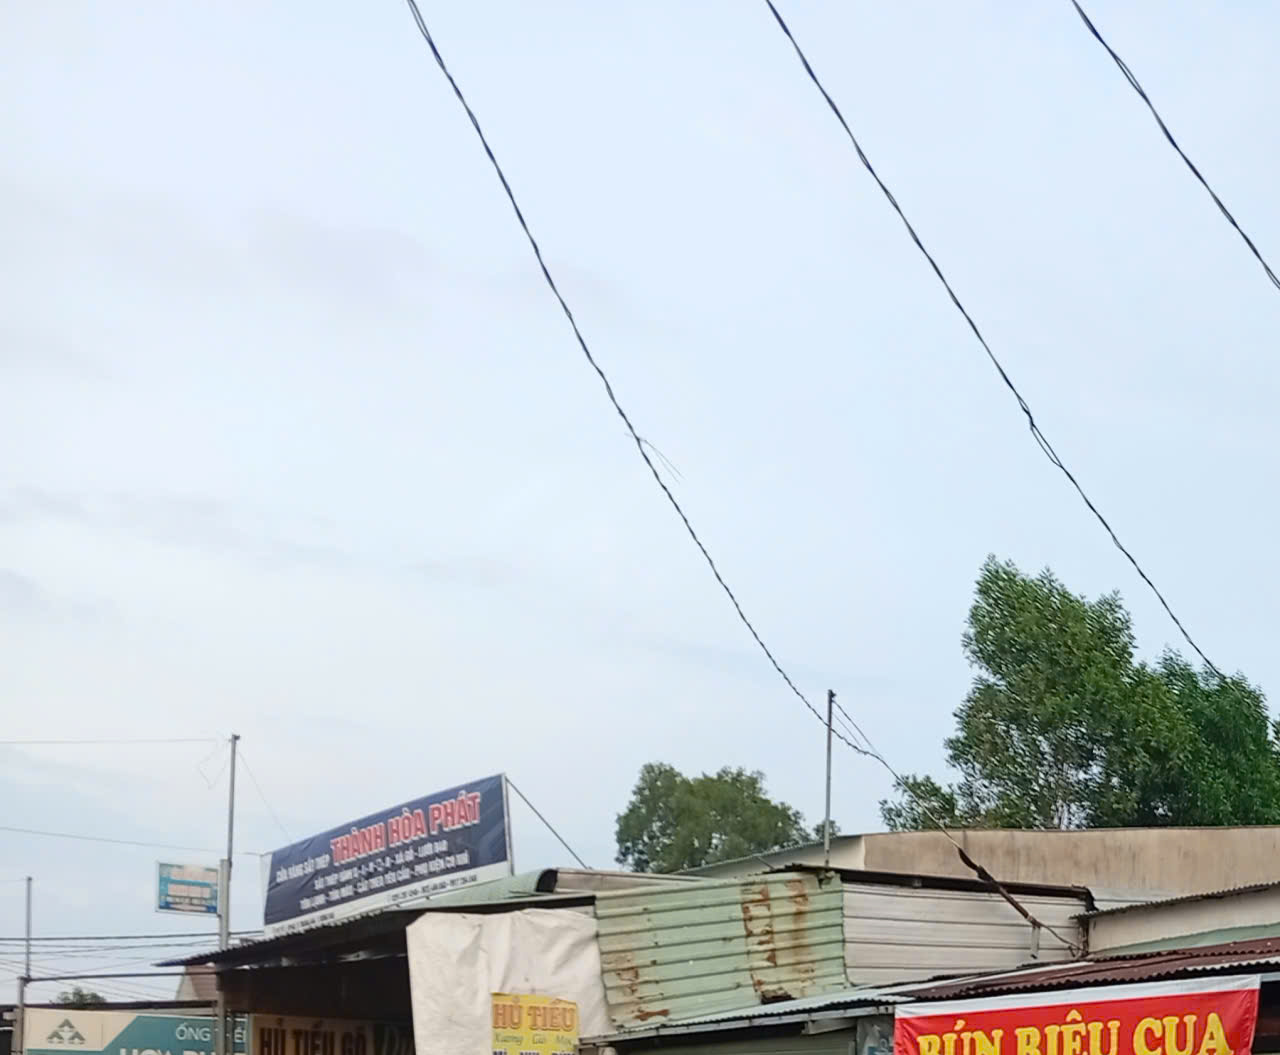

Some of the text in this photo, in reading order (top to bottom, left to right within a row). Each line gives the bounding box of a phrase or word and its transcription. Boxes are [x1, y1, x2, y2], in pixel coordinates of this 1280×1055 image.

[330, 826, 386, 866] THÀNH
[388, 807, 428, 847] HÒA
[429, 790, 481, 834] PHÁT
[175, 1022, 212, 1042] ỐNG
